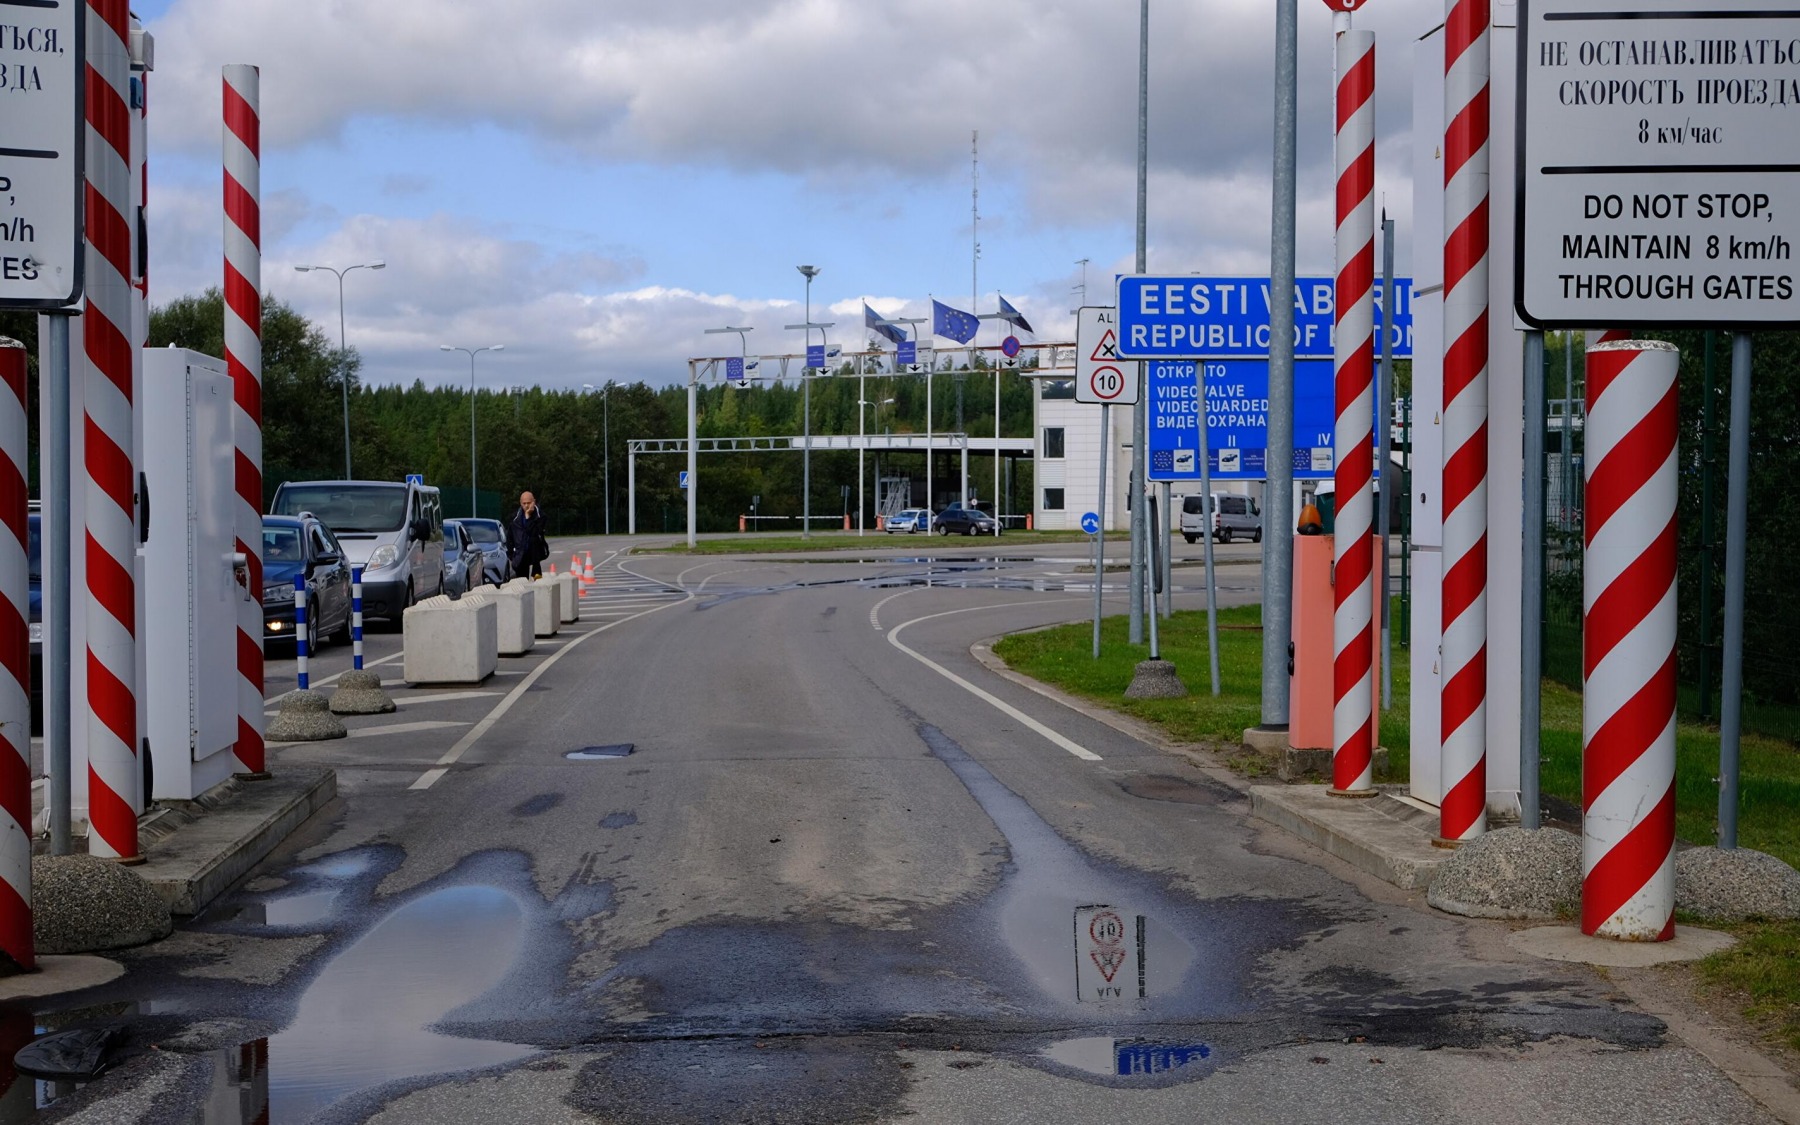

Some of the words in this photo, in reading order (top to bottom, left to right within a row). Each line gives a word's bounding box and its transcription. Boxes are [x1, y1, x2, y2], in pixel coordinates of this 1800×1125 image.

[1540, 41, 1568, 67] НЕ
[1697, 79, 1800, 109] ПРОЕЗДА
[1638, 118, 1650, 144] 8
[1657, 117, 1723, 146] км/час
[1584, 194, 1623, 219] DO
[1632, 194, 1689, 219] NOT
[1697, 193, 1773, 222] STOP,
[1562, 234, 1691, 259] MAINTAIN
[1706, 235, 1720, 259] 8
[1729, 235, 1791, 260] km/h
[1140, 284, 1249, 315] EESTI
[1558, 275, 1693, 299] THROUGH
[1703, 275, 1793, 300] GATES
[1131, 324, 1271, 347] REPUBLIC
[1099, 375, 1116, 390] 10
[1157, 414, 1267, 430] ВИДЕОХРАНА
[1177, 435, 1182, 448] I
[1228, 434, 1236, 447] II
[1318, 432, 1331, 446] IV
